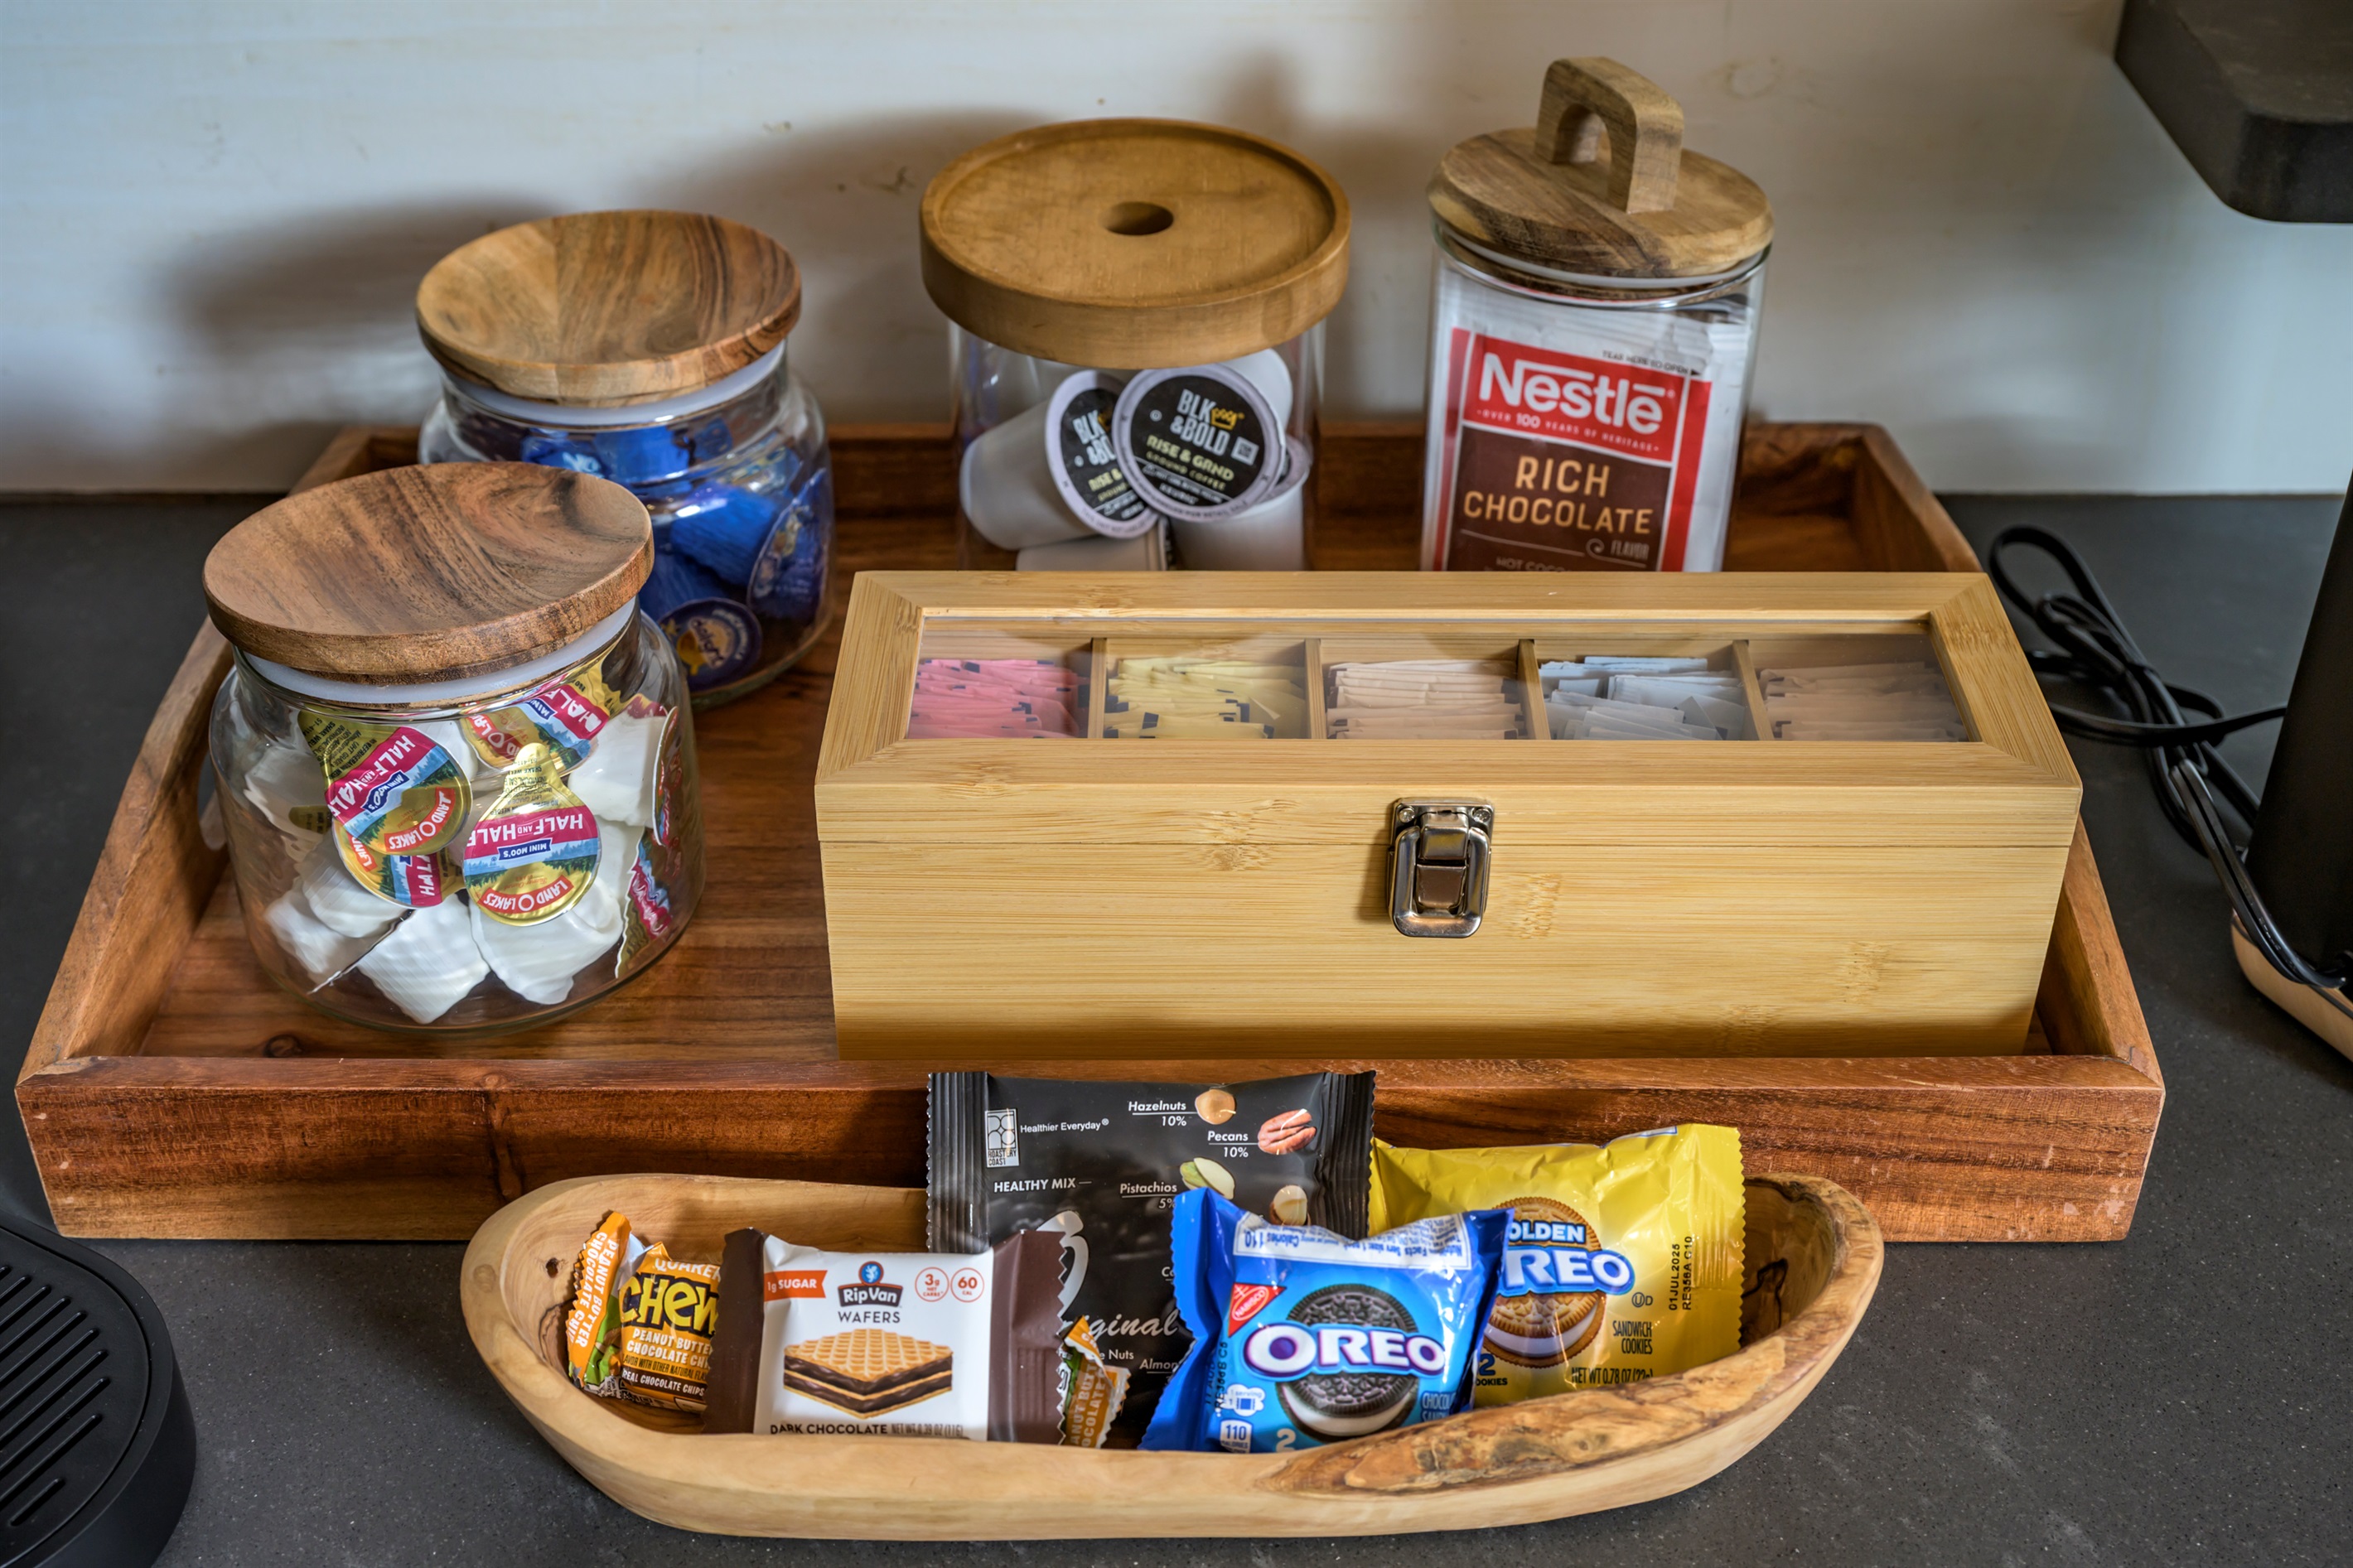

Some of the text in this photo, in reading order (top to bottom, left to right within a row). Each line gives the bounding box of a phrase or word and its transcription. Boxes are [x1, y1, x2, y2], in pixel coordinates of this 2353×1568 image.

[1176, 388, 1217, 424] BLK
[1072, 409, 1106, 445] BLK
[1170, 415, 1231, 456] &BOLD
[1483, 409, 1654, 452] OVER 100 YEARS OF HERITAGE
[1147, 434, 1234, 482] RISE & GRND
[1145, 451, 1189, 475] GROUND
[1188, 470, 1227, 492] COFFEE
[1515, 455, 1611, 499] RICH
[1463, 490, 1654, 534] CHOCOLATE
[1610, 539, 1650, 561] FLAVOR
[1495, 556, 1524, 569] HOT
[319, 721, 336, 737] SHAKE
[347, 741, 360, 755] UHT
[331, 735, 417, 818] HALF AND HALF
[384, 774, 405, 790] MINI
[432, 790, 453, 823] LAND
[389, 828, 423, 851] LAKES
[466, 813, 583, 847] HALF AND HALF
[503, 842, 548, 858] MINI MOO'S
[483, 892, 516, 910] LAKES
[536, 880, 569, 905] LAND
[1128, 1100, 1186, 1112] Hazelnuts
[1020, 1123, 1058, 1134] Healthier
[1162, 1116, 1187, 1127] 10%
[1207, 1130, 1249, 1142] Pecans
[1223, 1146, 1249, 1159] 10%
[988, 1158, 1007, 1167] COAST
[994, 1178, 1076, 1194] HEALTHY MIX
[1119, 1181, 1177, 1194] Pistachios
[1266, 1233, 1300, 1248] Calories
[1510, 1223, 1585, 1242] OLDEN
[1404, 1247, 1428, 1257] Facts
[580, 1232, 608, 1310] CHOCOLATE
[1505, 1249, 1631, 1288] REO
[1669, 1242, 1680, 1310] 01JUL2025
[767, 1278, 817, 1293] 1g SUGAR
[925, 1273, 940, 1286] 3g
[957, 1277, 978, 1289] 60
[575, 1238, 620, 1348] PEANUT BUTTER
[1235, 1290, 1265, 1317] NABISCO
[838, 1311, 901, 1324] WAFERS
[632, 1328, 675, 1348] PEANUT
[1612, 1320, 1652, 1338] SANDWICH
[626, 1339, 689, 1364] CHOCOLATE
[1109, 1349, 1135, 1361] Nuts
[1245, 1323, 1447, 1374] OREO
[1621, 1339, 1653, 1355] COOKIES
[639, 1358, 652, 1369] WITH
[652, 1361, 670, 1373] OTHER
[670, 1366, 693, 1379] NATURAL
[1479, 1353, 1496, 1376] 2
[622, 1368, 704, 1397] REAL CHOCOLATE CHIPS
[1572, 1368, 1587, 1384] NET
[1589, 1368, 1602, 1383] WT
[1602, 1368, 1621, 1384] 0.78
[771, 1424, 804, 1435] DARK
[806, 1424, 887, 1435] CHOCOLATE
[891, 1423, 905, 1434] NET
[917, 1424, 933, 1435] 0.39
[1225, 1424, 1247, 1440] 110
[1277, 1428, 1297, 1452] 2
